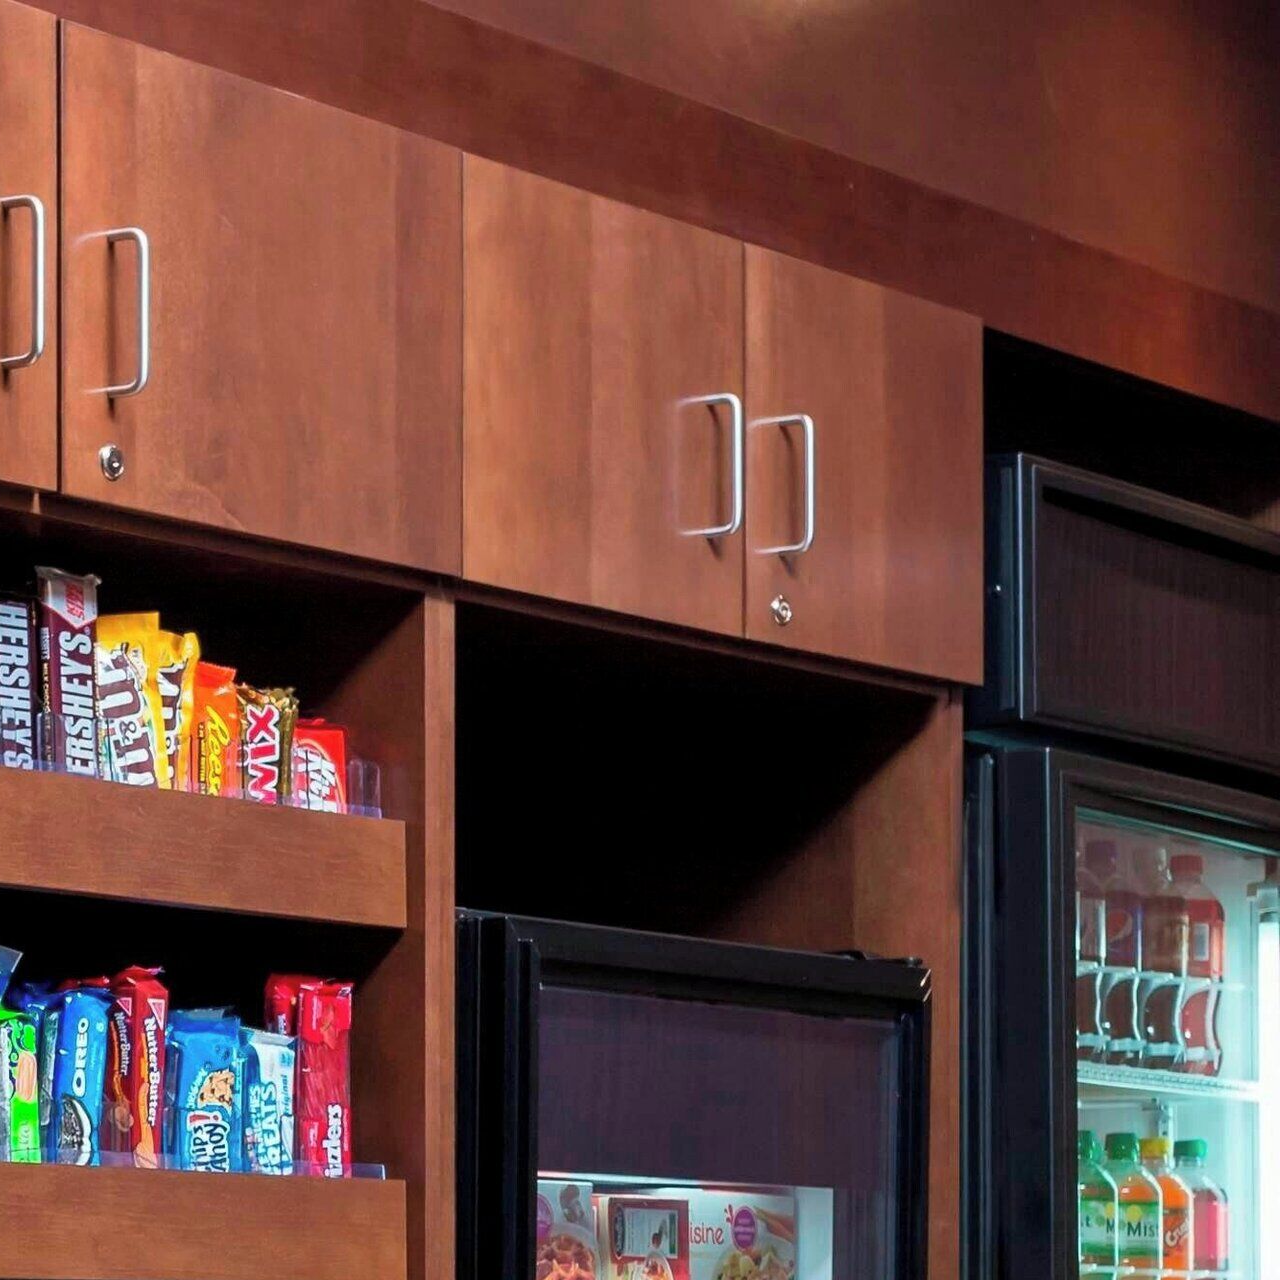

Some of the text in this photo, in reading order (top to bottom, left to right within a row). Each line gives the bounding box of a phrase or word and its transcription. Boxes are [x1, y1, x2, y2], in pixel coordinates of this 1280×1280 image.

[72, 1016, 89, 1098] OREO
[114, 1011, 131, 1077] Nutter Butter
[144, 1017, 160, 1127] Nutter Butter
[1127, 1222, 1160, 1237] Mis
